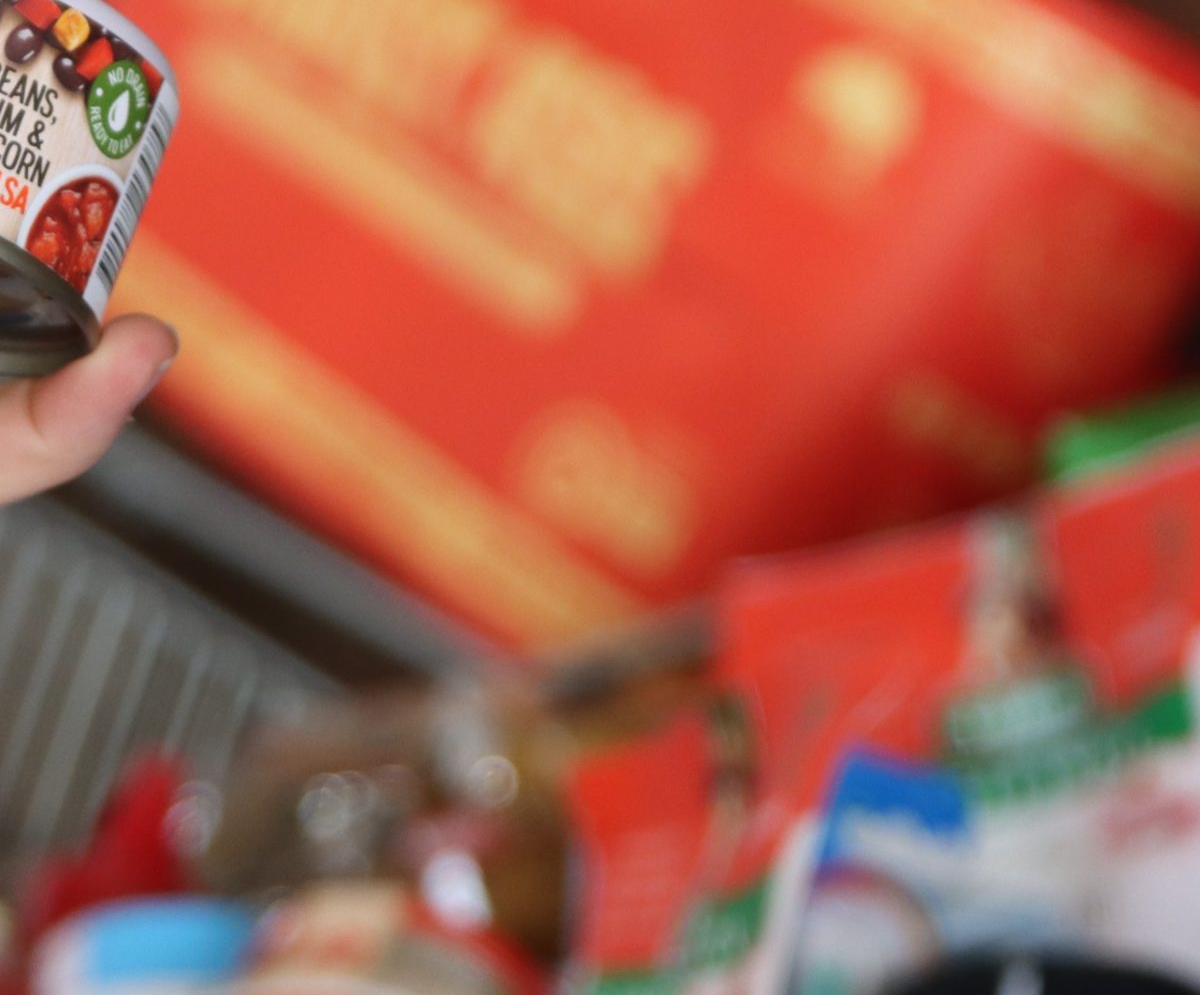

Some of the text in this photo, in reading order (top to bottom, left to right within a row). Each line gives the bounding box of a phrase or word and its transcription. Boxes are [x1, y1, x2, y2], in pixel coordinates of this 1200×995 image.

[107, 67, 124, 86] NO
[27, 119, 46, 150] &
[90, 106, 110, 146] READY
